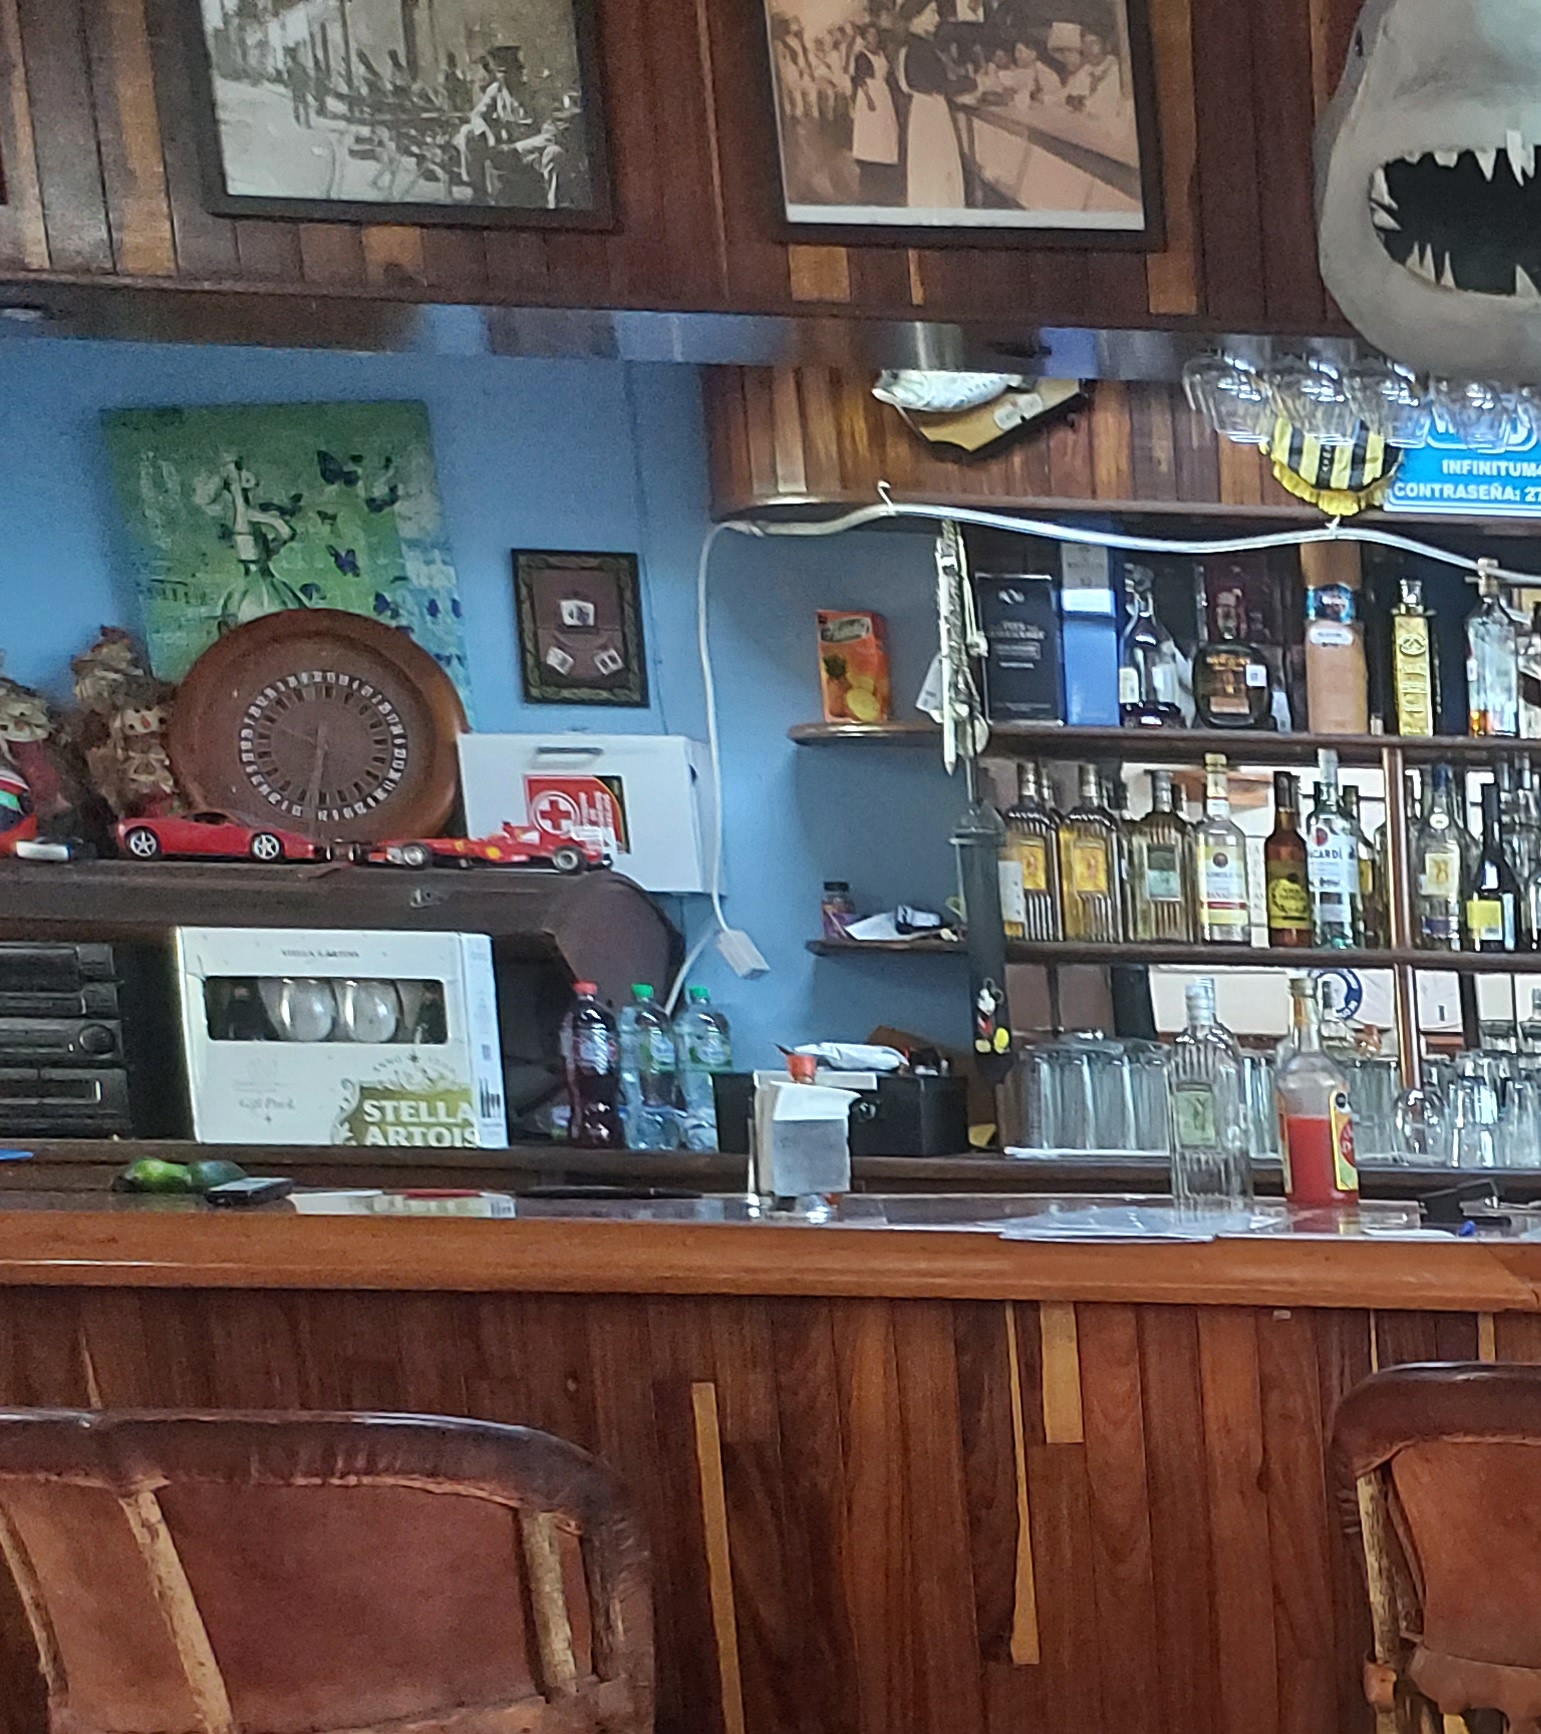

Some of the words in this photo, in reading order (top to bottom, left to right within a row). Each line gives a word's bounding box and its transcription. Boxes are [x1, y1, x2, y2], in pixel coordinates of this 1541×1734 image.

[1393, 480, 1520, 502] CONTRASEÑA:
[361, 1098, 477, 1124] STELLA
[364, 1124, 481, 1148] ARTOIS
